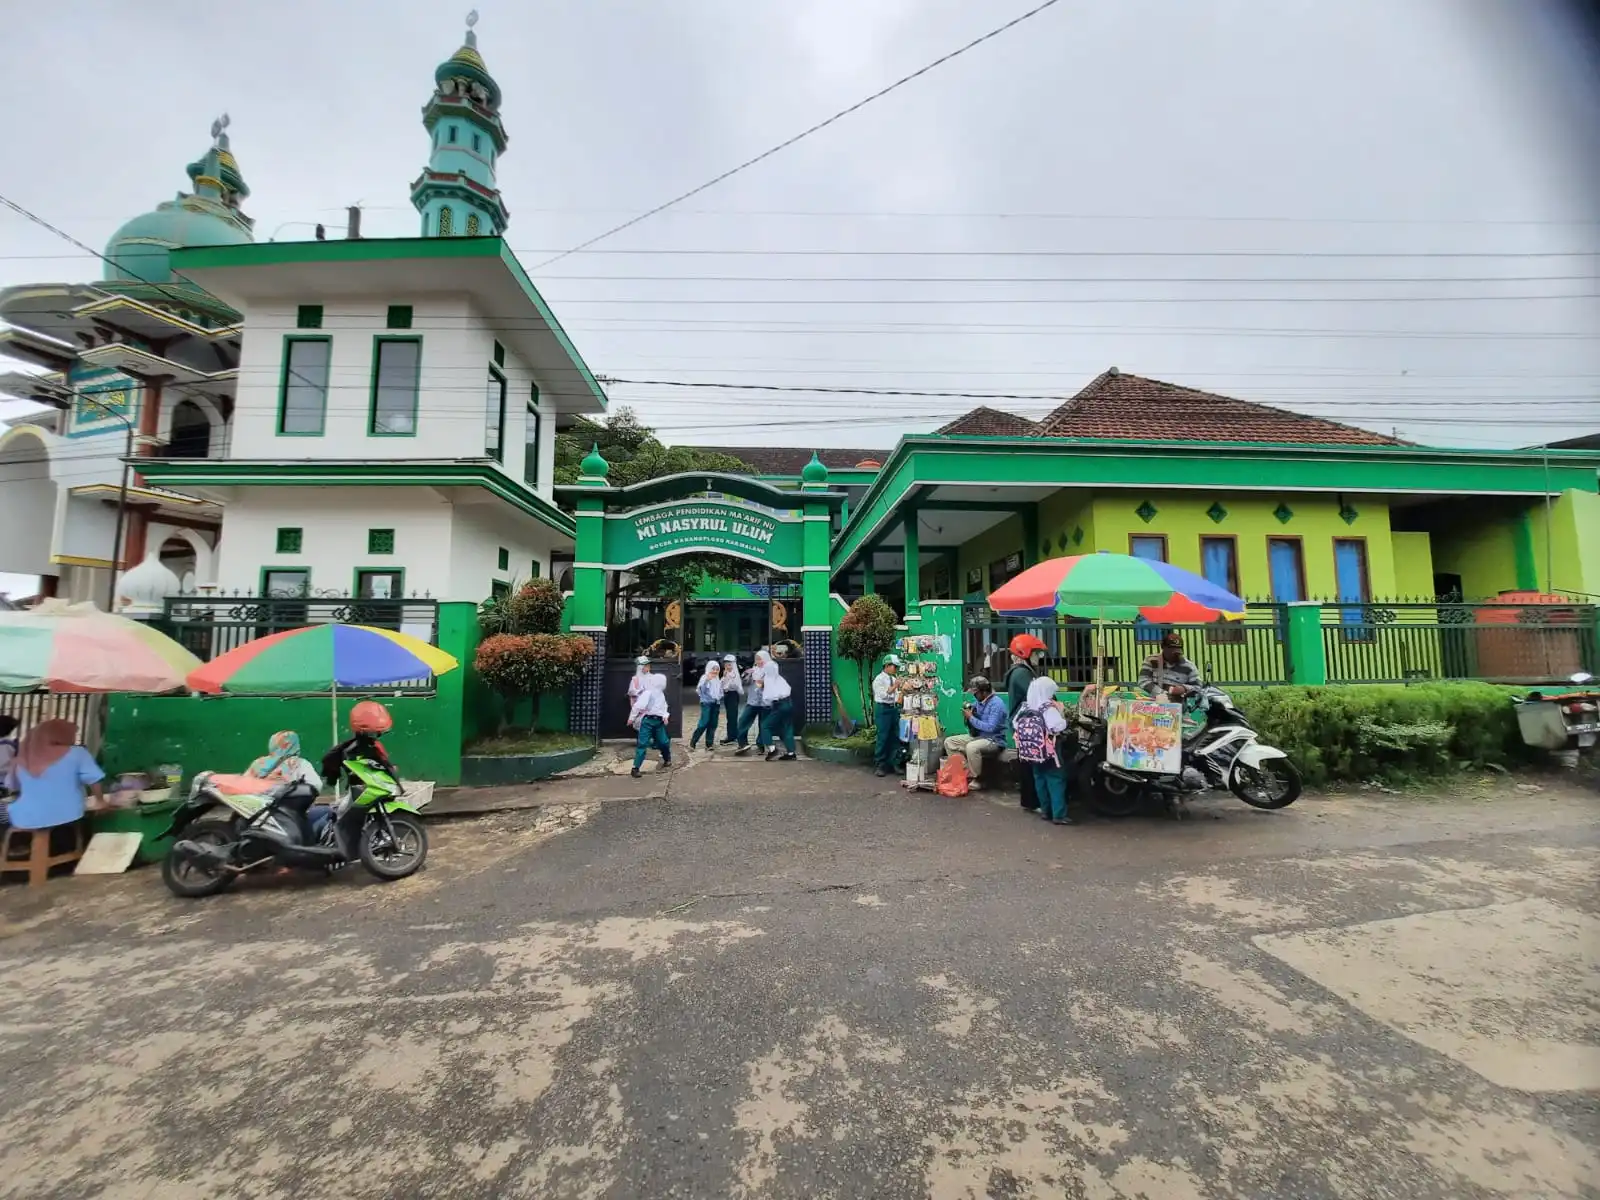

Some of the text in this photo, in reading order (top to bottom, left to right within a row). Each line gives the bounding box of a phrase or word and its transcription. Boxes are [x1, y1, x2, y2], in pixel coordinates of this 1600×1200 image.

[634, 508, 776, 530] LEMBAGA PENDIDIKAN MA'ARIF NU
[636, 517, 774, 545] MI NASYRUL ULUM
